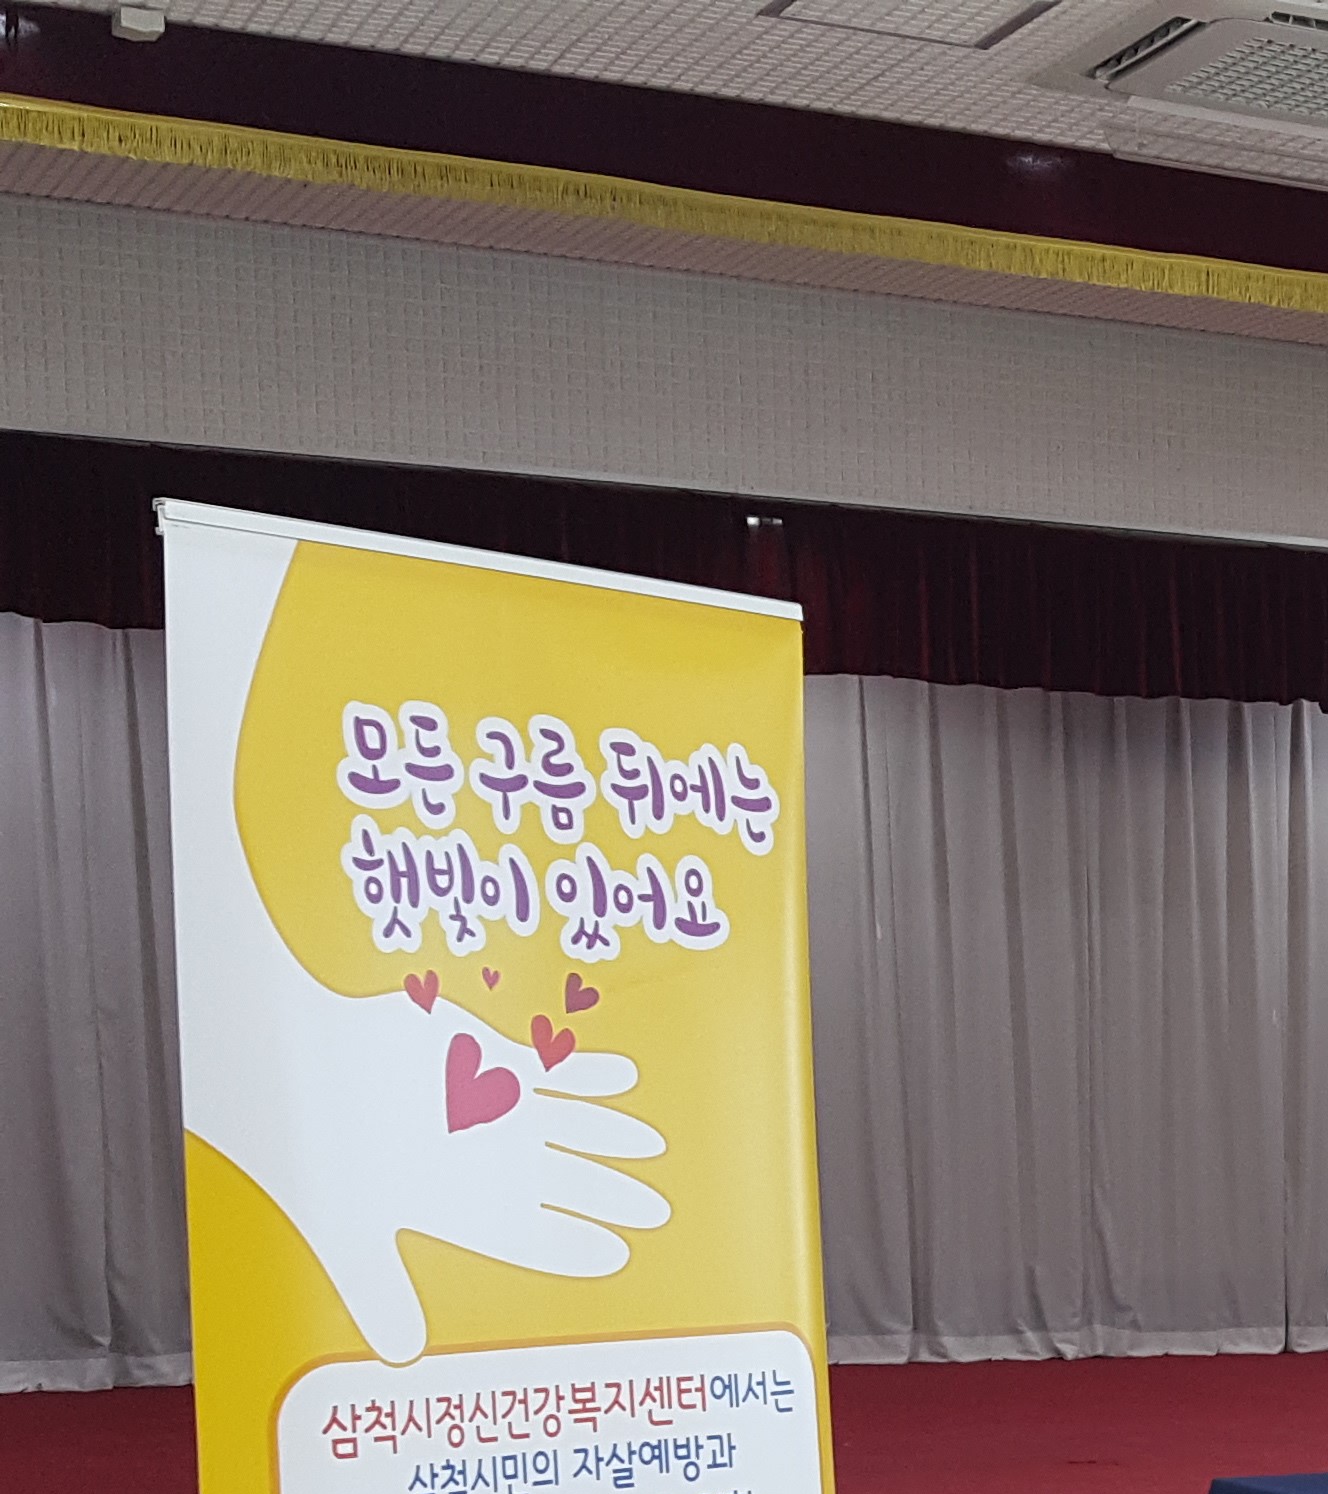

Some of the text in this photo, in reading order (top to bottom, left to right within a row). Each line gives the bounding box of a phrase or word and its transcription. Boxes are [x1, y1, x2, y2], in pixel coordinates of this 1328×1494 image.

[346, 715, 771, 842] 모든 구름 뒤에는
[352, 828, 720, 950] 햇빛이 있어요
[321, 1369, 796, 1461] 삼척시정신건강복지센터에서는
[572, 1432, 737, 1491] 자살예방과
